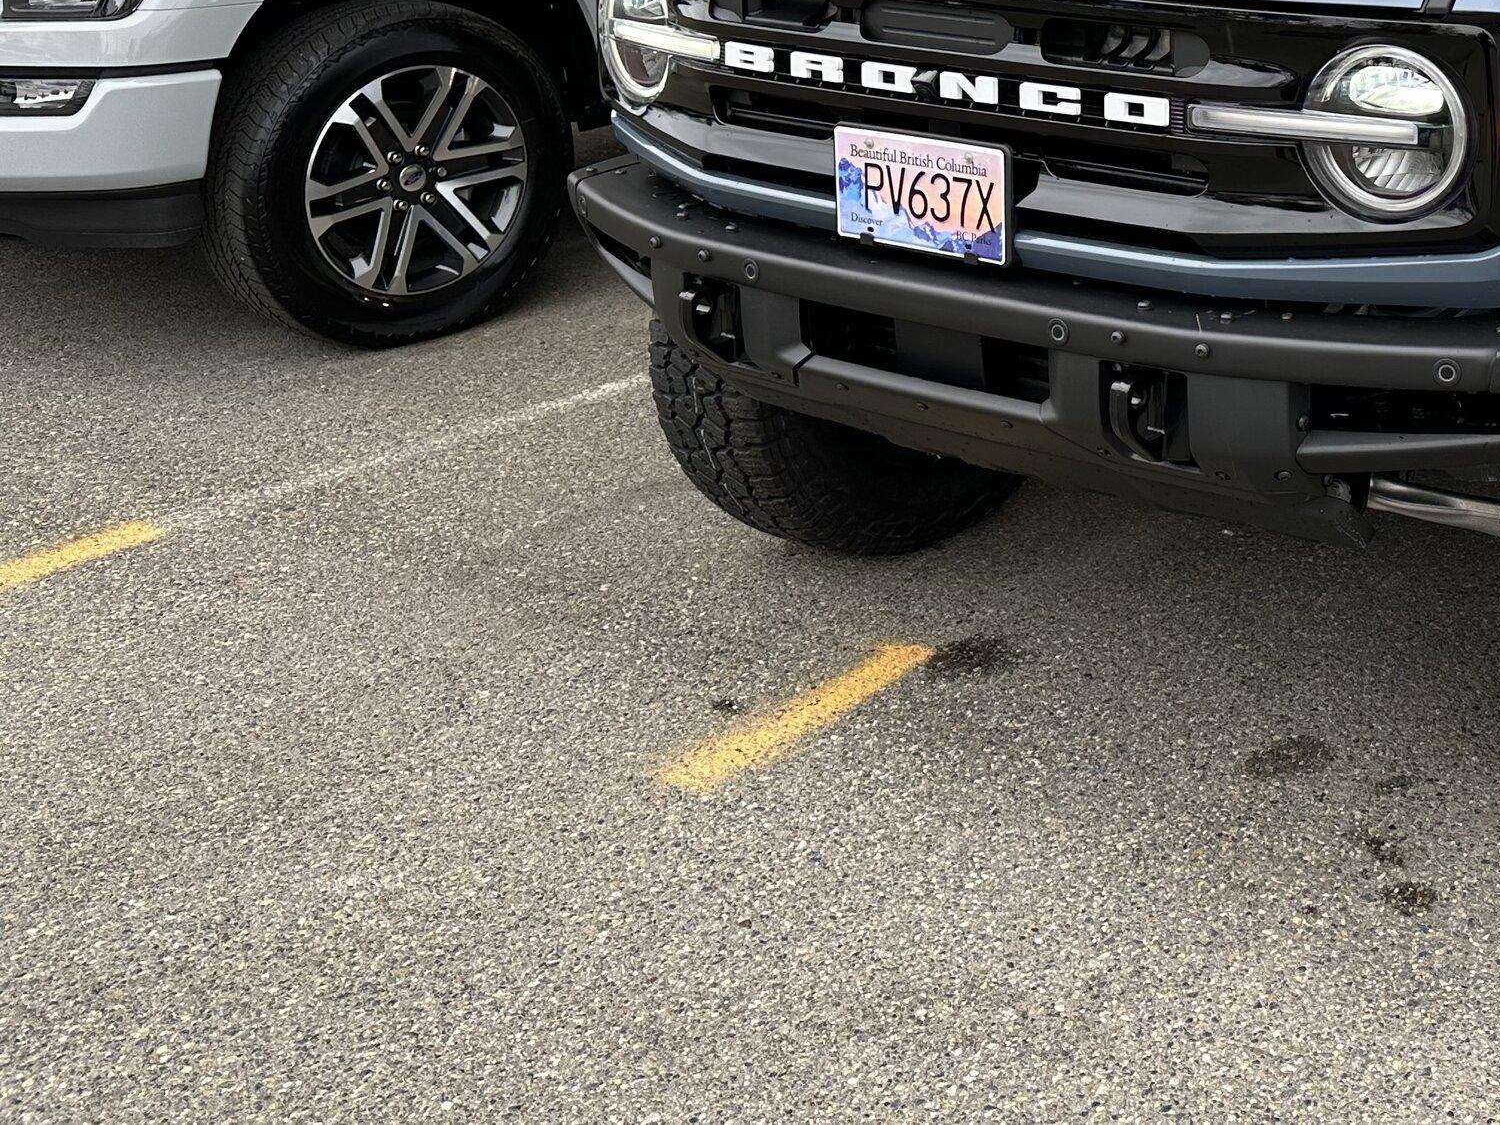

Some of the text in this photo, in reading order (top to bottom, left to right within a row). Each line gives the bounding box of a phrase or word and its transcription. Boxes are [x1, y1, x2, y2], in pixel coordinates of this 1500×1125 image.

[723, 40, 1171, 129] BRONCO
[849, 143, 988, 178] Beautiful British Columbia
[850, 211, 884, 226] Discover
[864, 161, 996, 233] PV637X
